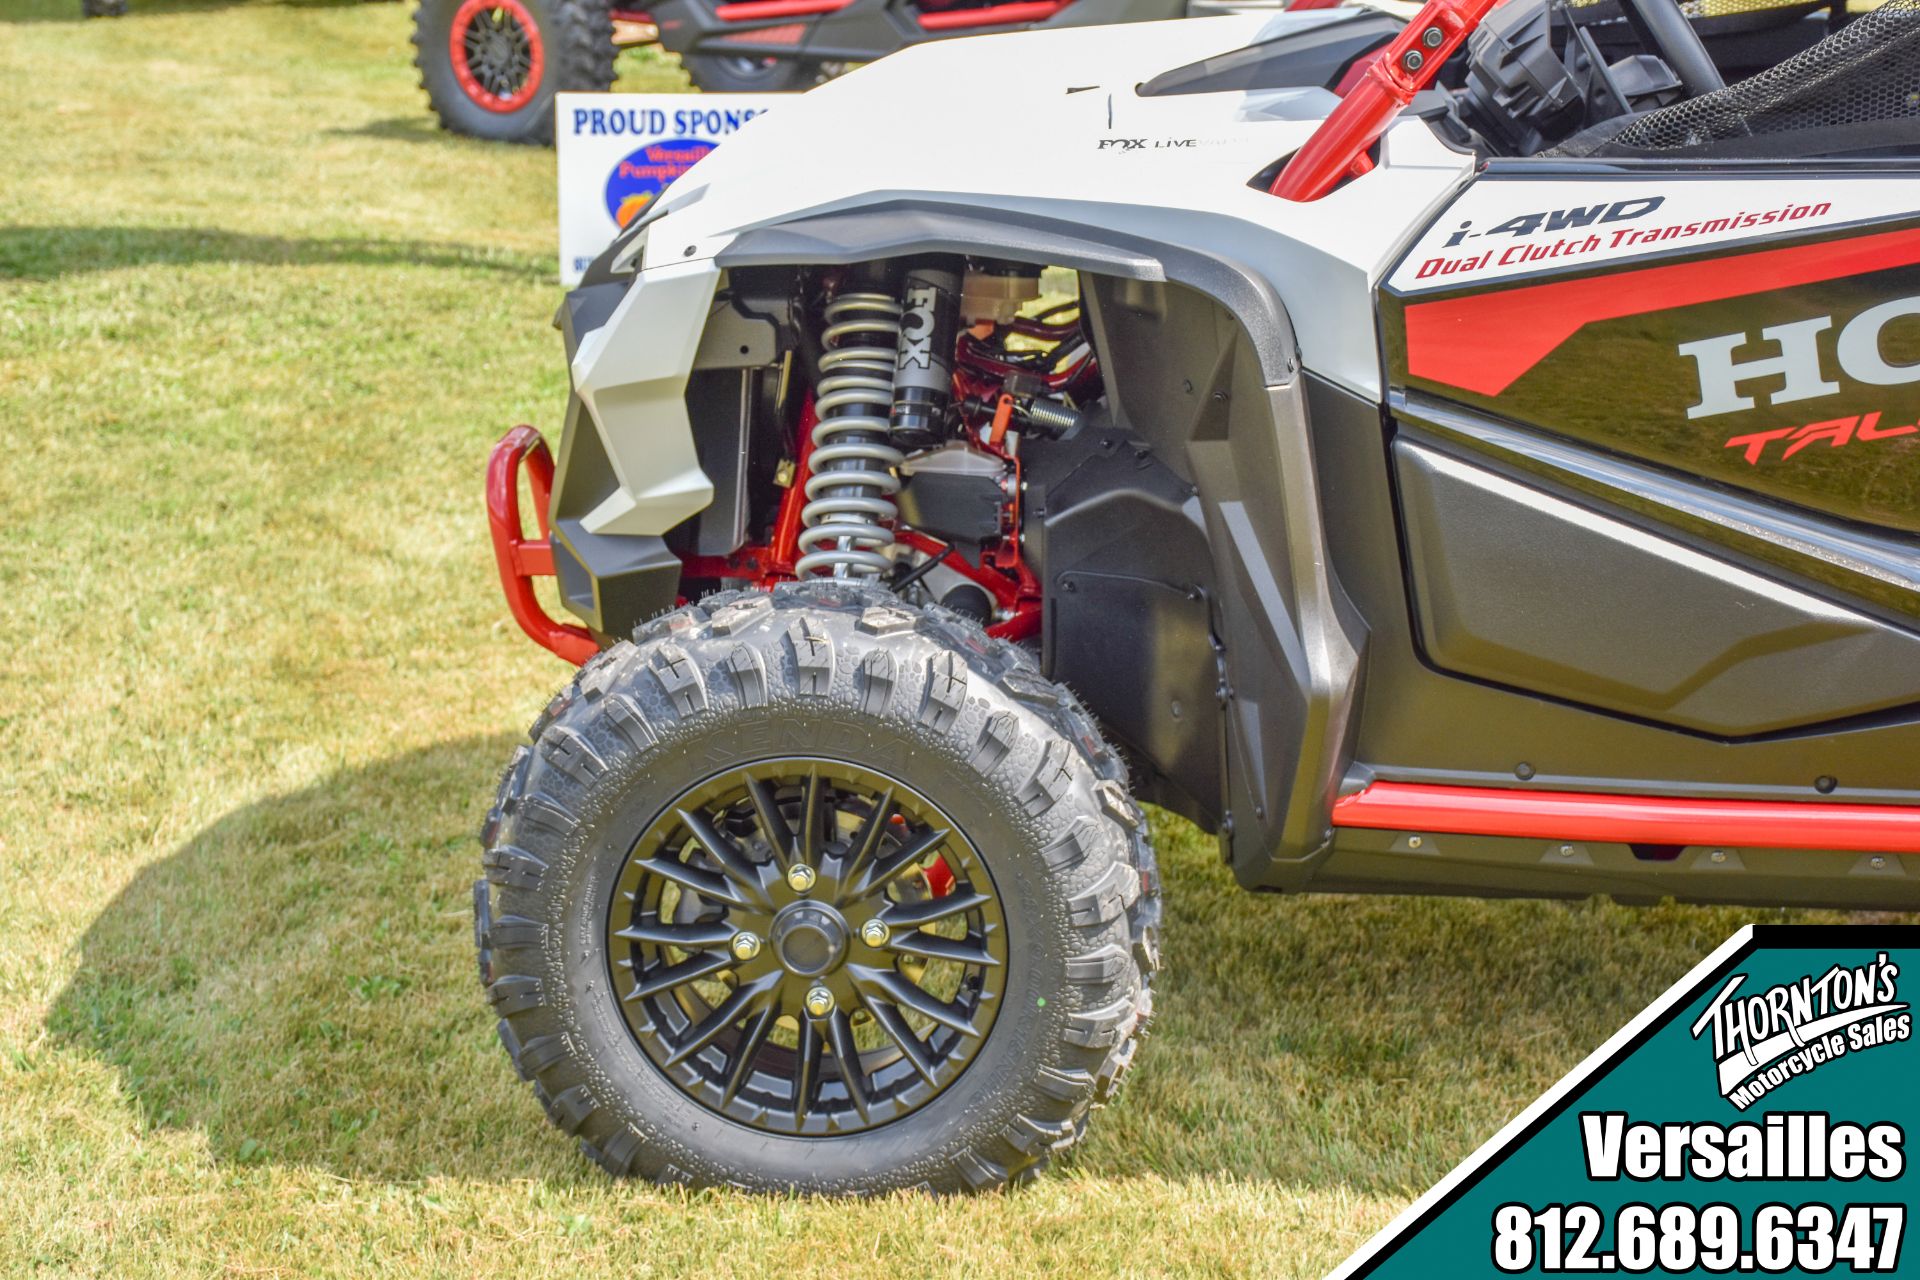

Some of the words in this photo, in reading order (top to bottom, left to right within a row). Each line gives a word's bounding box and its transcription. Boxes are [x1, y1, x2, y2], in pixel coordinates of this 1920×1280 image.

[573, 108, 665, 135] PROUD
[674, 108, 768, 135] SPON
[1098, 138, 1147, 152] FOX
[1415, 250, 1493, 280] Dual
[1498, 235, 1600, 266] Clutch
[1609, 202, 1832, 250] Transmission
[1442, 196, 1666, 248] i-4WD
[898, 286, 937, 369] FOX
[1724, 411, 1920, 466] TAL
[686, 718, 914, 774] KENDA
